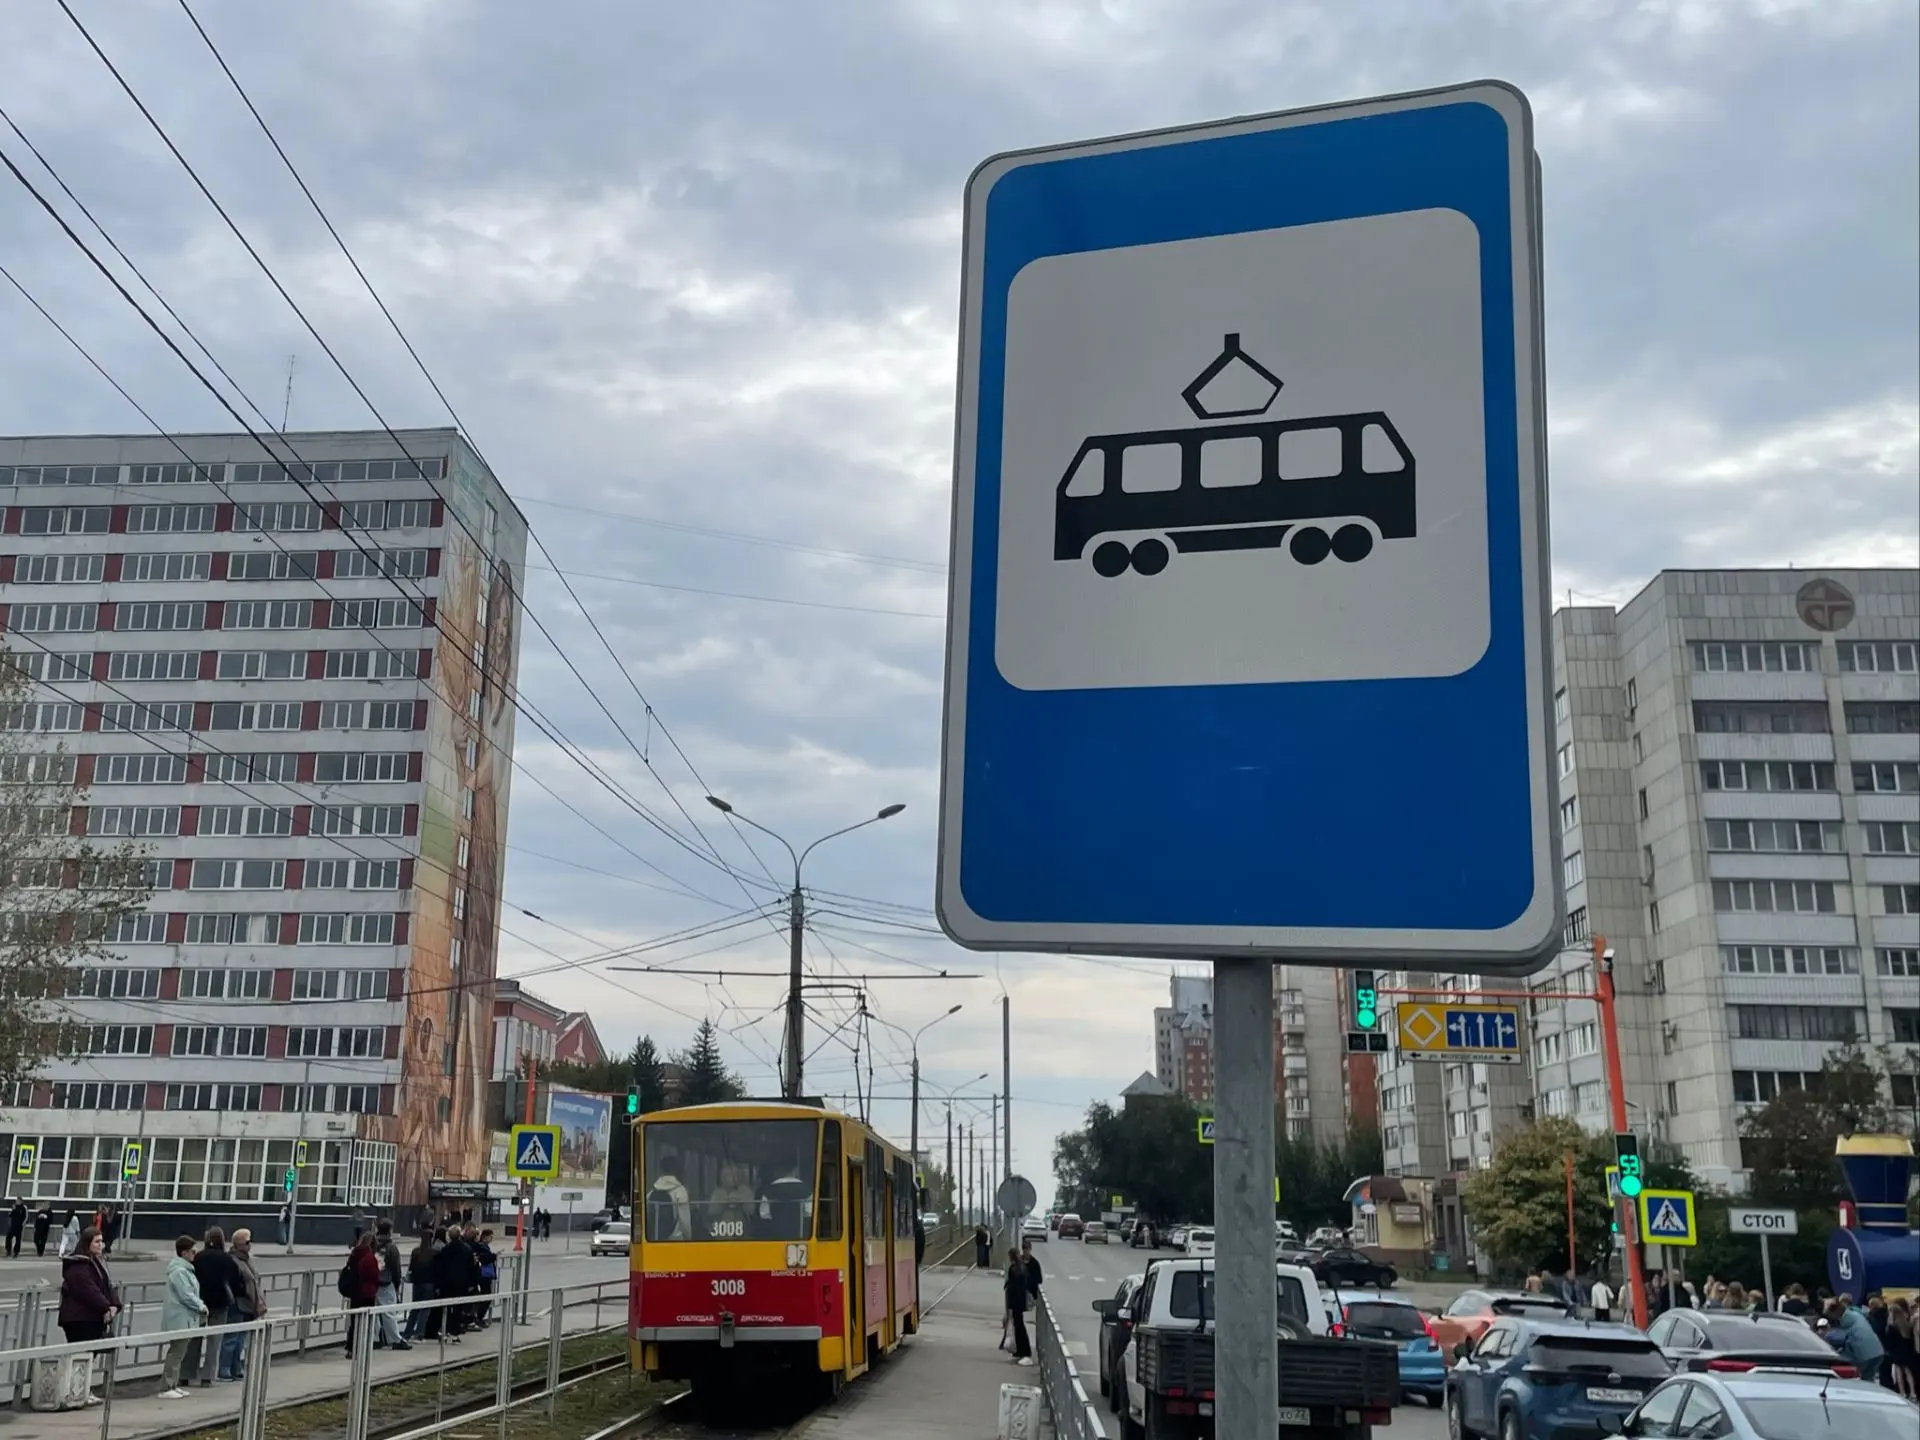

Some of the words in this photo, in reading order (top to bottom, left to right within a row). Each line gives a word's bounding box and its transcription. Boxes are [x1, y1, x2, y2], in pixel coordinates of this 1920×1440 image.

[1357, 989, 1375, 1009] 53
[1619, 1154, 1640, 1175] 53
[710, 1221, 744, 1236] 3008
[1742, 1213, 1786, 1229] СТОП
[711, 1279, 745, 1295] 3008
[740, 1314, 785, 1323] ДИСТАНЦИЮ
